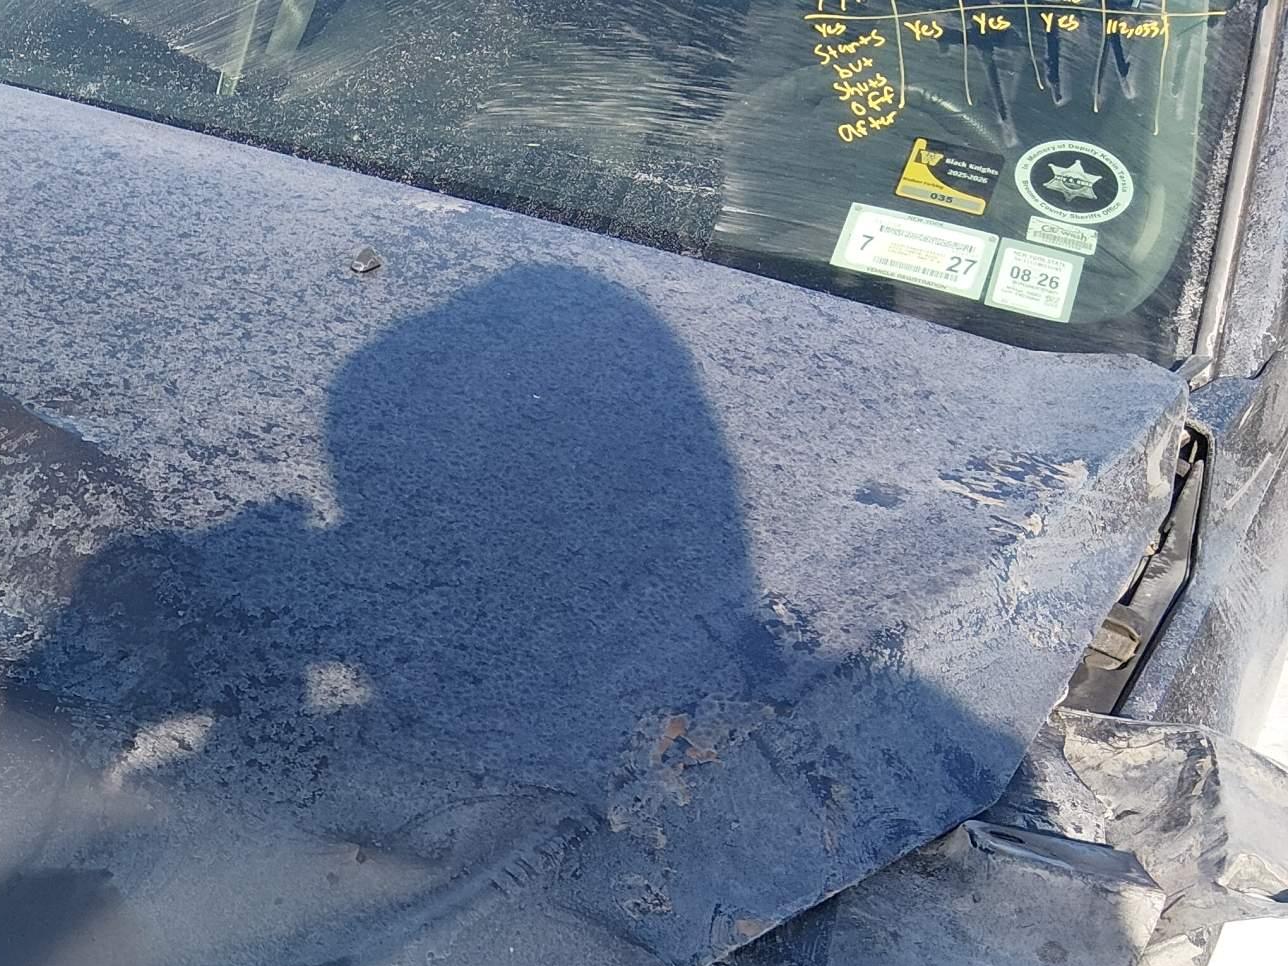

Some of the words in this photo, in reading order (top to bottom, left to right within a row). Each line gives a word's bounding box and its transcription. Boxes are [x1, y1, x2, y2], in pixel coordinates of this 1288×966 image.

[904, 19, 944, 41] Yes
[972, 12, 1011, 34] Yes
[1040, 12, 1080, 32] Yes
[1068, 143, 1099, 156] Deputy
[1099, 152, 1120, 171] Kevin
[946, 169, 989, 184] 2025-2026
[930, 192, 953, 204] 035
[1039, 202, 1068, 219] County
[1102, 201, 1122, 216] Office
[860, 234, 875, 251] 7
[946, 256, 978, 276] 27
[1010, 265, 1032, 282] 08
[1037, 272, 1060, 290] 26
